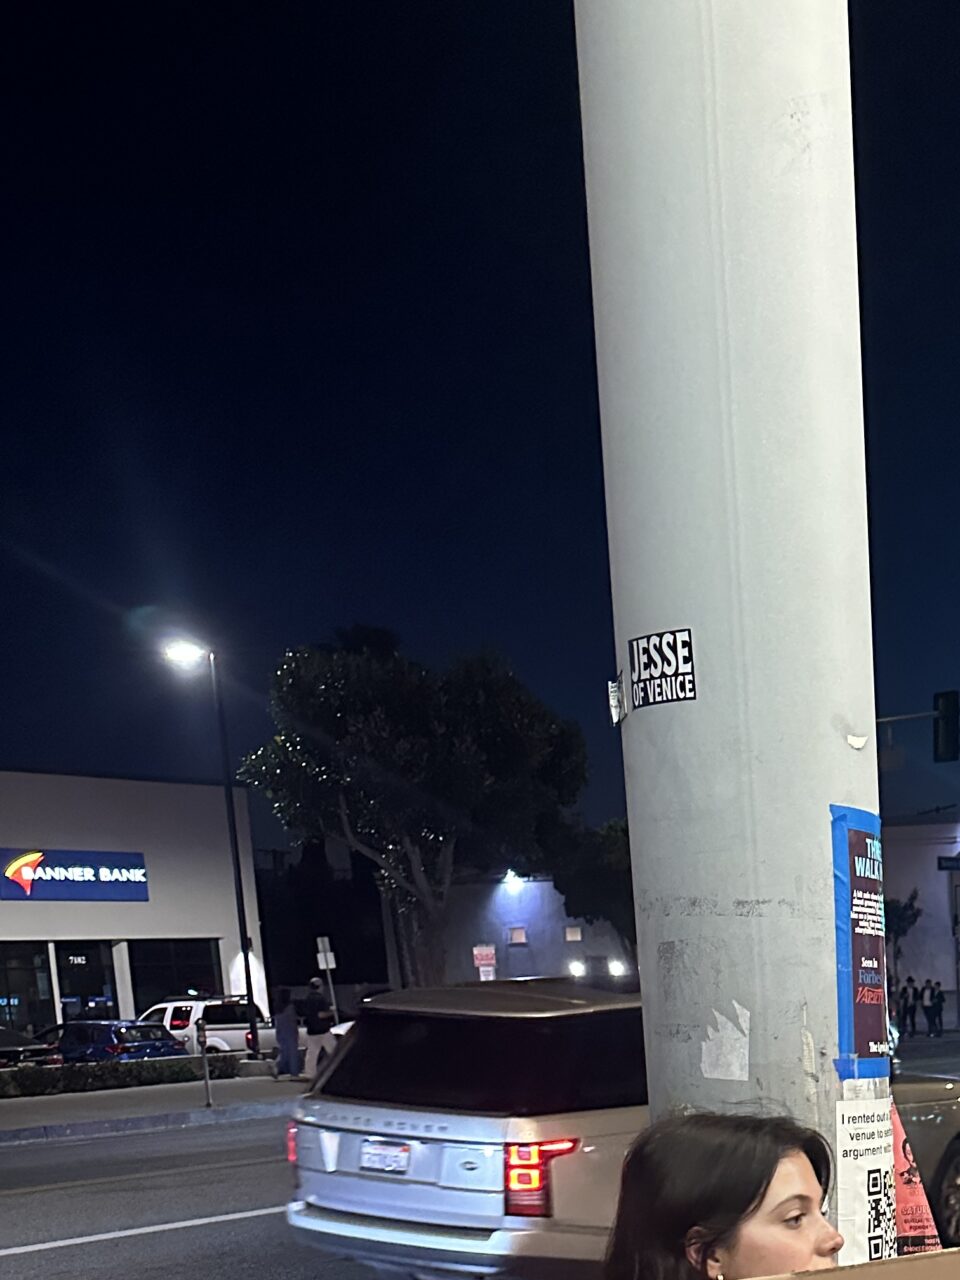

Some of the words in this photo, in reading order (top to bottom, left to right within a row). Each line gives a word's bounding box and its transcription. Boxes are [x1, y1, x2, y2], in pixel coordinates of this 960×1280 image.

[631, 631, 692, 682] JESSE
[633, 682, 644, 707] OF
[646, 674, 695, 703] VENICE
[21, 866, 96, 881] BANNER
[99, 867, 147, 882] BANK
[841, 1113, 845, 1125] I
[848, 1113, 875, 1125] rented
[849, 1131, 876, 1141] venue
[842, 1146, 882, 1160] argument
